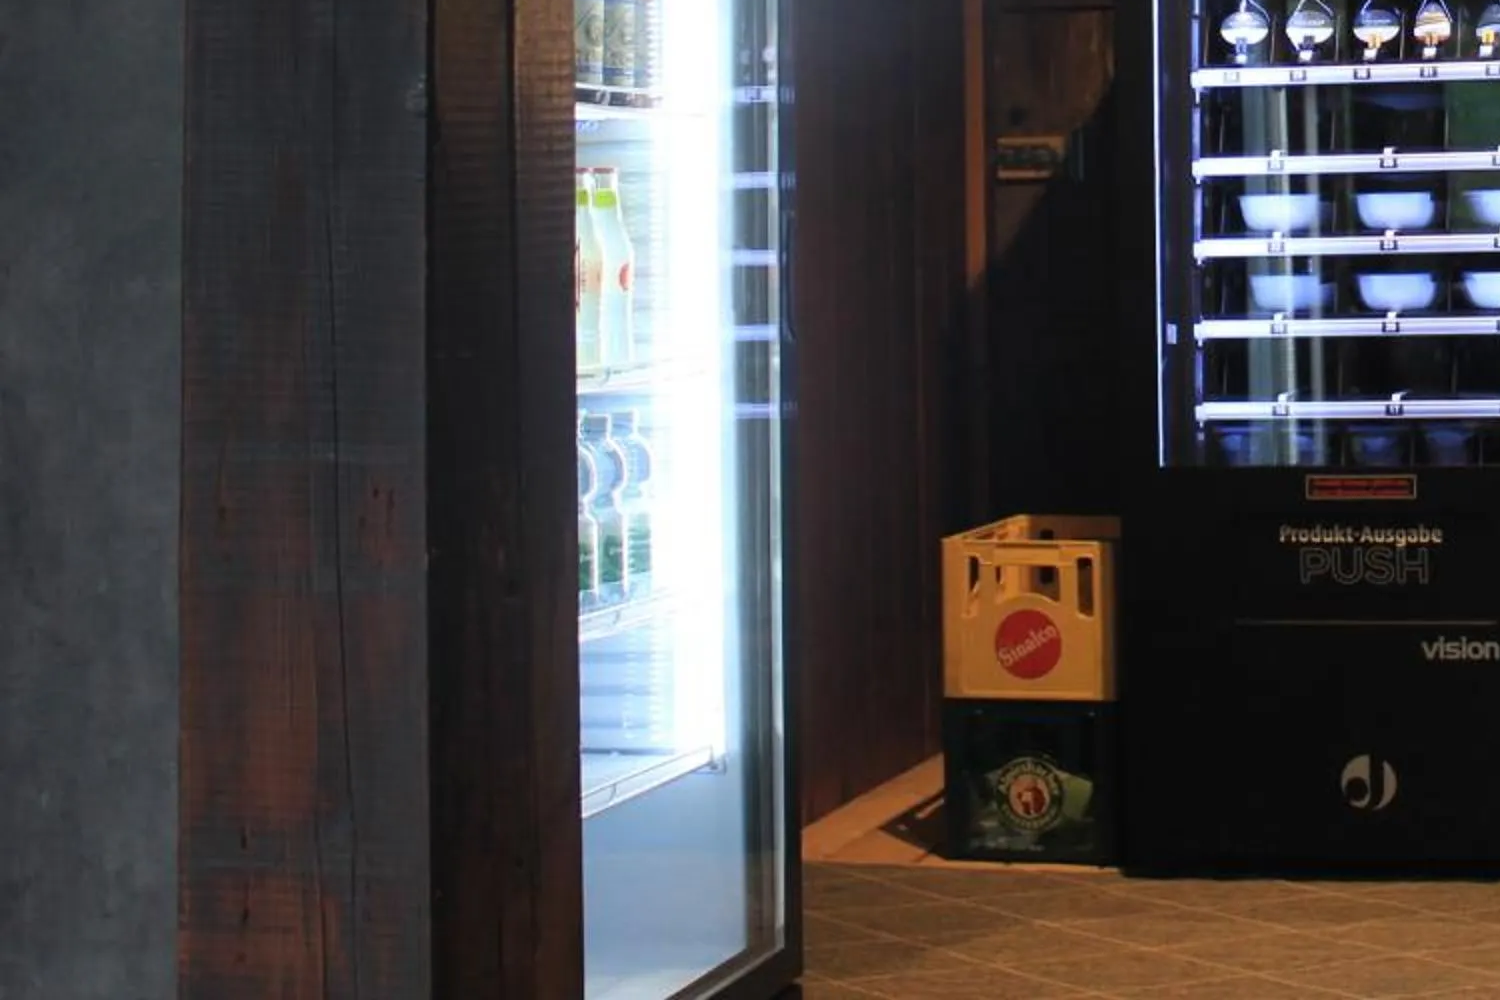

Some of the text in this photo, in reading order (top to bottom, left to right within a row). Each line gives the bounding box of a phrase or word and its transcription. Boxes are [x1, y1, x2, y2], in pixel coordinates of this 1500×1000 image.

[1279, 525, 1443, 546] Produkt-Ausgabe
[1300, 547, 1429, 584] PUSH
[1421, 636, 1500, 660] vision
